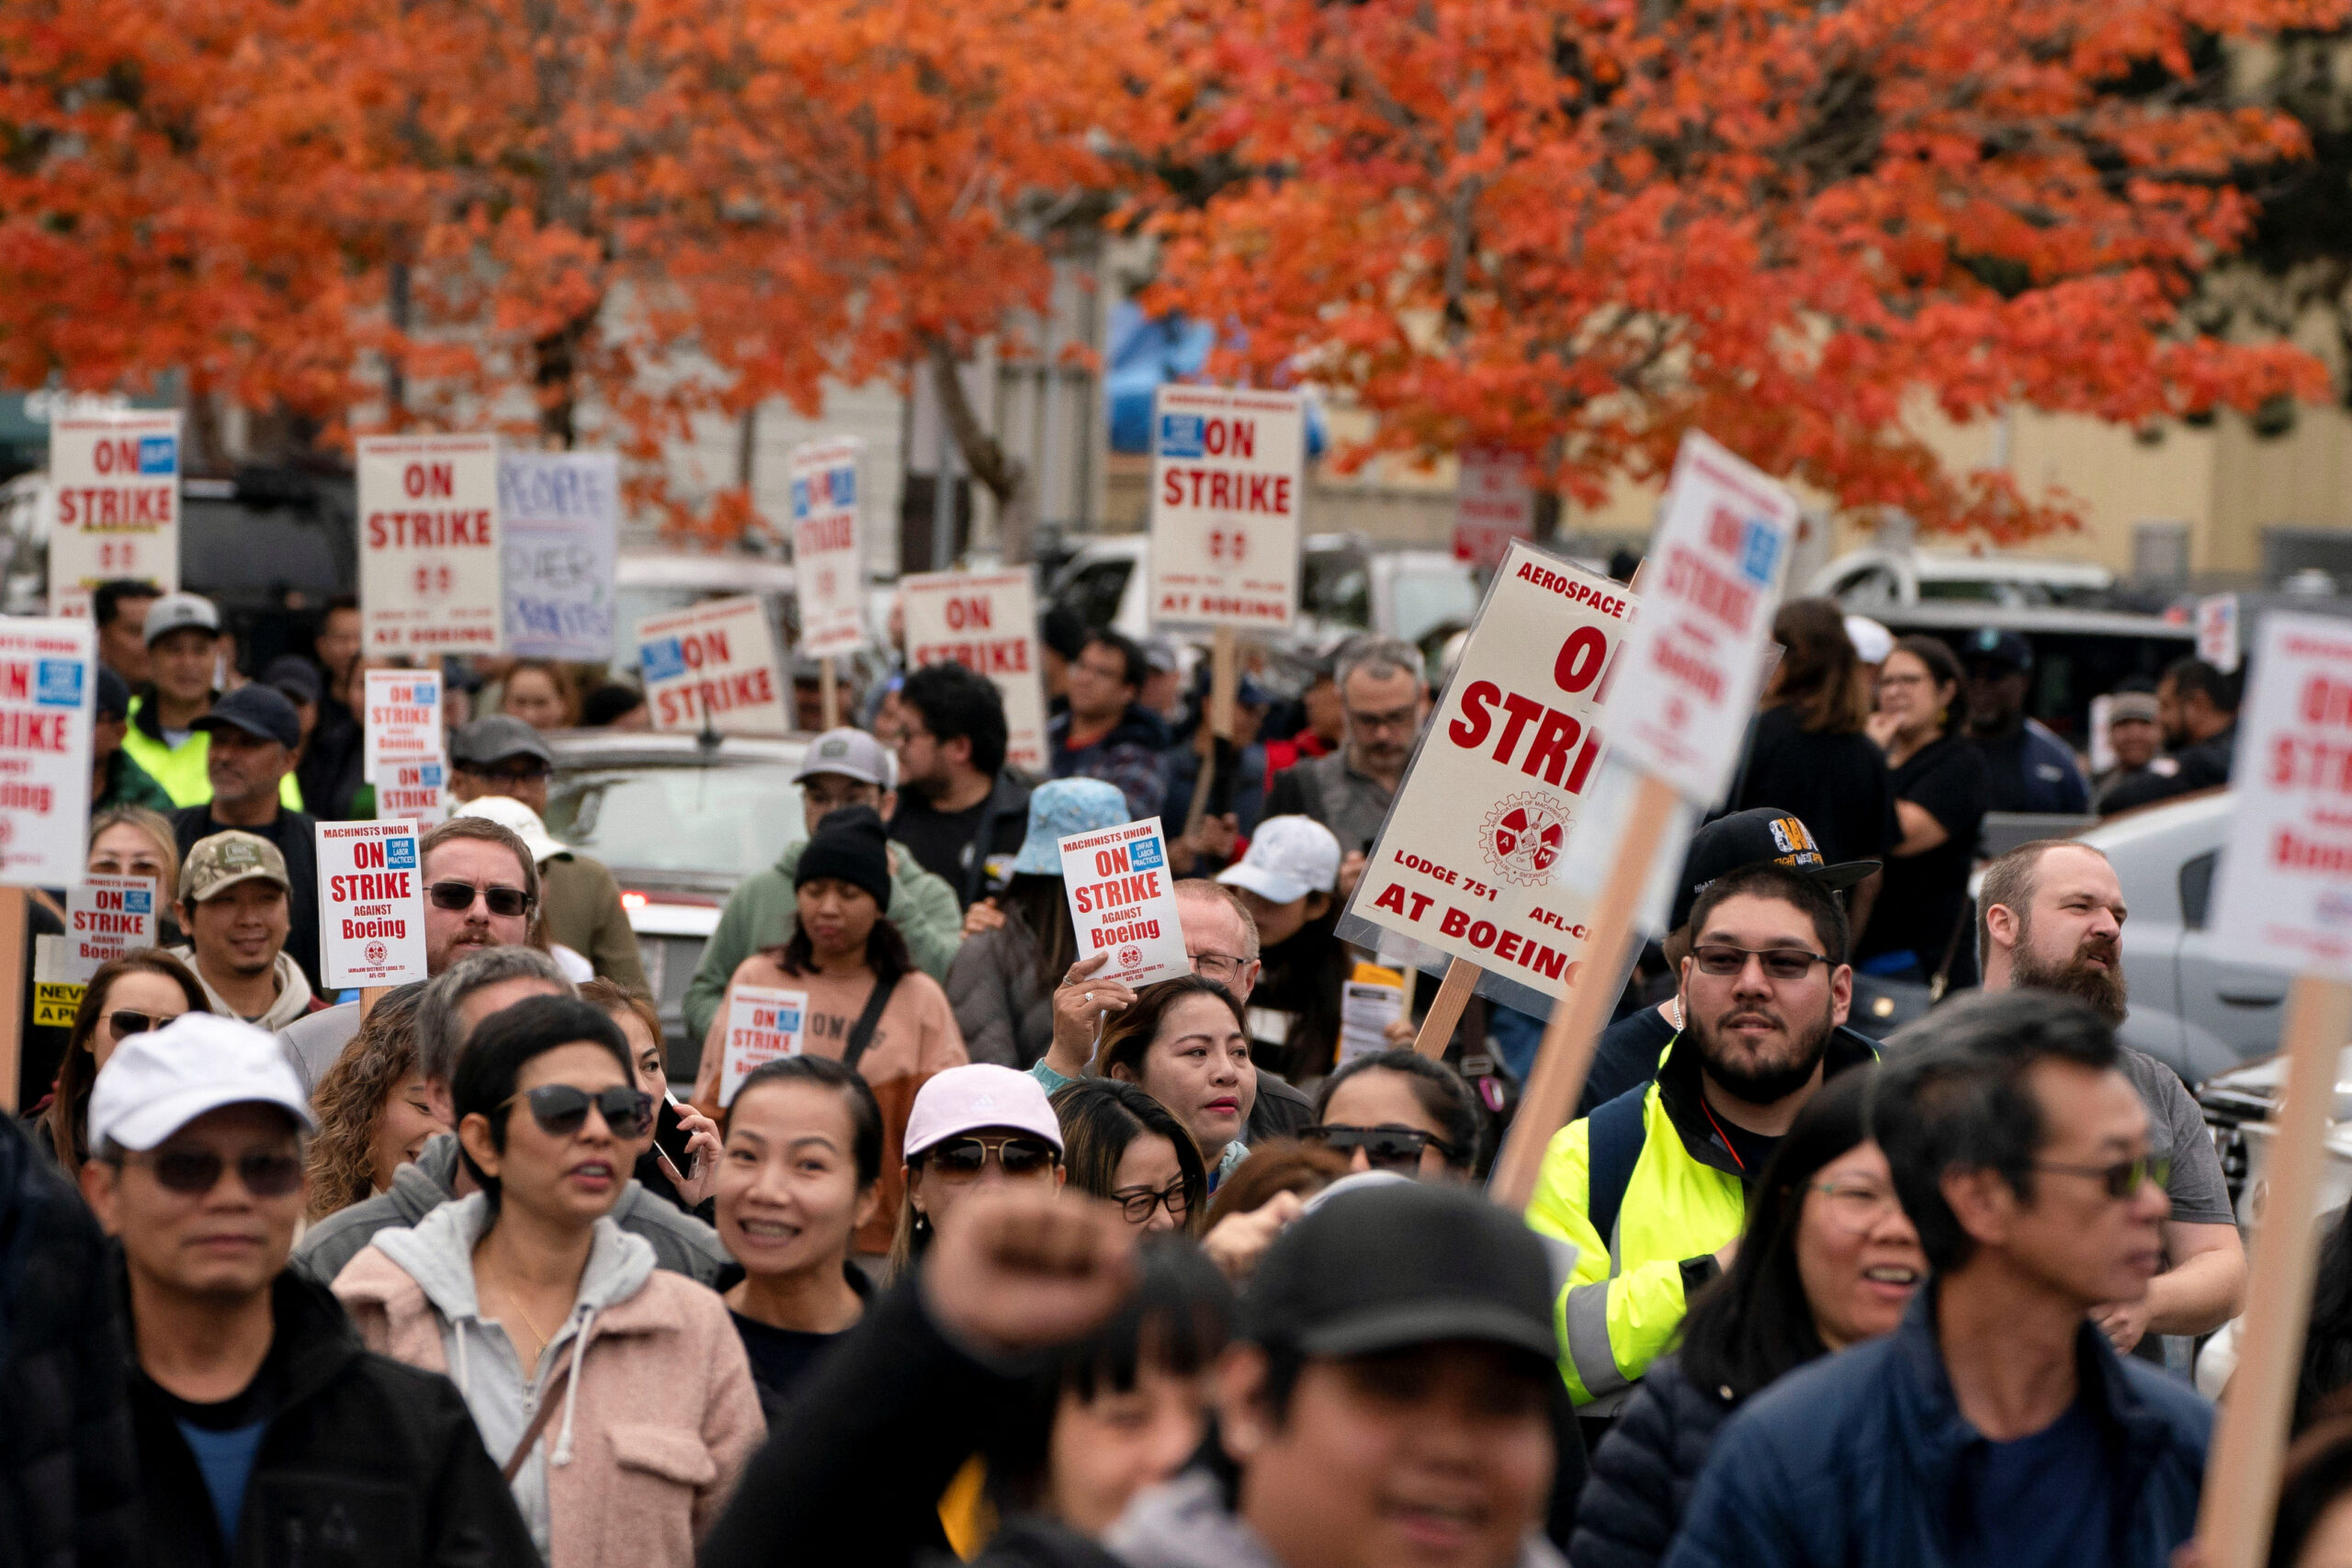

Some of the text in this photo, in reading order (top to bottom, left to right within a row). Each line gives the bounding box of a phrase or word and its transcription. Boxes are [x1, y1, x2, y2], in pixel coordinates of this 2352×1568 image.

[1204, 418, 1254, 457] ON
[95, 438, 140, 475] ON
[402, 462, 453, 499] ON
[1164, 468, 1290, 514] STRIKE
[59, 487, 172, 527] STRIKE
[368, 510, 492, 549] STRIKE
[1516, 561, 1625, 619] AEROSPACE
[946, 598, 991, 630] ON
[682, 628, 730, 671] ON
[390, 685, 413, 703] ON
[658, 666, 775, 725] STRIKE
[373, 706, 430, 725] STRIKE
[1449, 680, 1608, 795] STRI
[399, 768, 420, 785] ON
[383, 789, 437, 808] STRIKE
[323, 825, 410, 839] MACHINISTS UNION
[391, 840, 410, 849] UNFAIR
[1063, 825, 1152, 852] MACHINISTS UNION
[1135, 840, 1154, 850] UNFAIR
[353, 841, 385, 869] ON
[392, 848, 410, 856] LABOR
[1095, 846, 1130, 878] ON
[1136, 848, 1155, 858] LABOR
[331, 872, 412, 902] STRIKE
[1394, 849, 1498, 902] LODGE 751
[96, 890, 123, 910] ON
[1075, 871, 1162, 914] STRIKE
[1374, 883, 1435, 923] AT
[74, 910, 143, 935] STRIKE
[354, 904, 392, 917] AGAINST
[1102, 906, 1142, 925] AGAINST
[1528, 906, 1594, 942] AFL-CI
[91, 935, 125, 945] AGAINST
[342, 917, 406, 940] Boeing
[1091, 919, 1160, 949] Boeing
[40, 986, 87, 1000] NEV
[39, 1007, 53, 1021] A
[753, 1009, 776, 1028] ON
[732, 1029, 790, 1053] STRIKE
